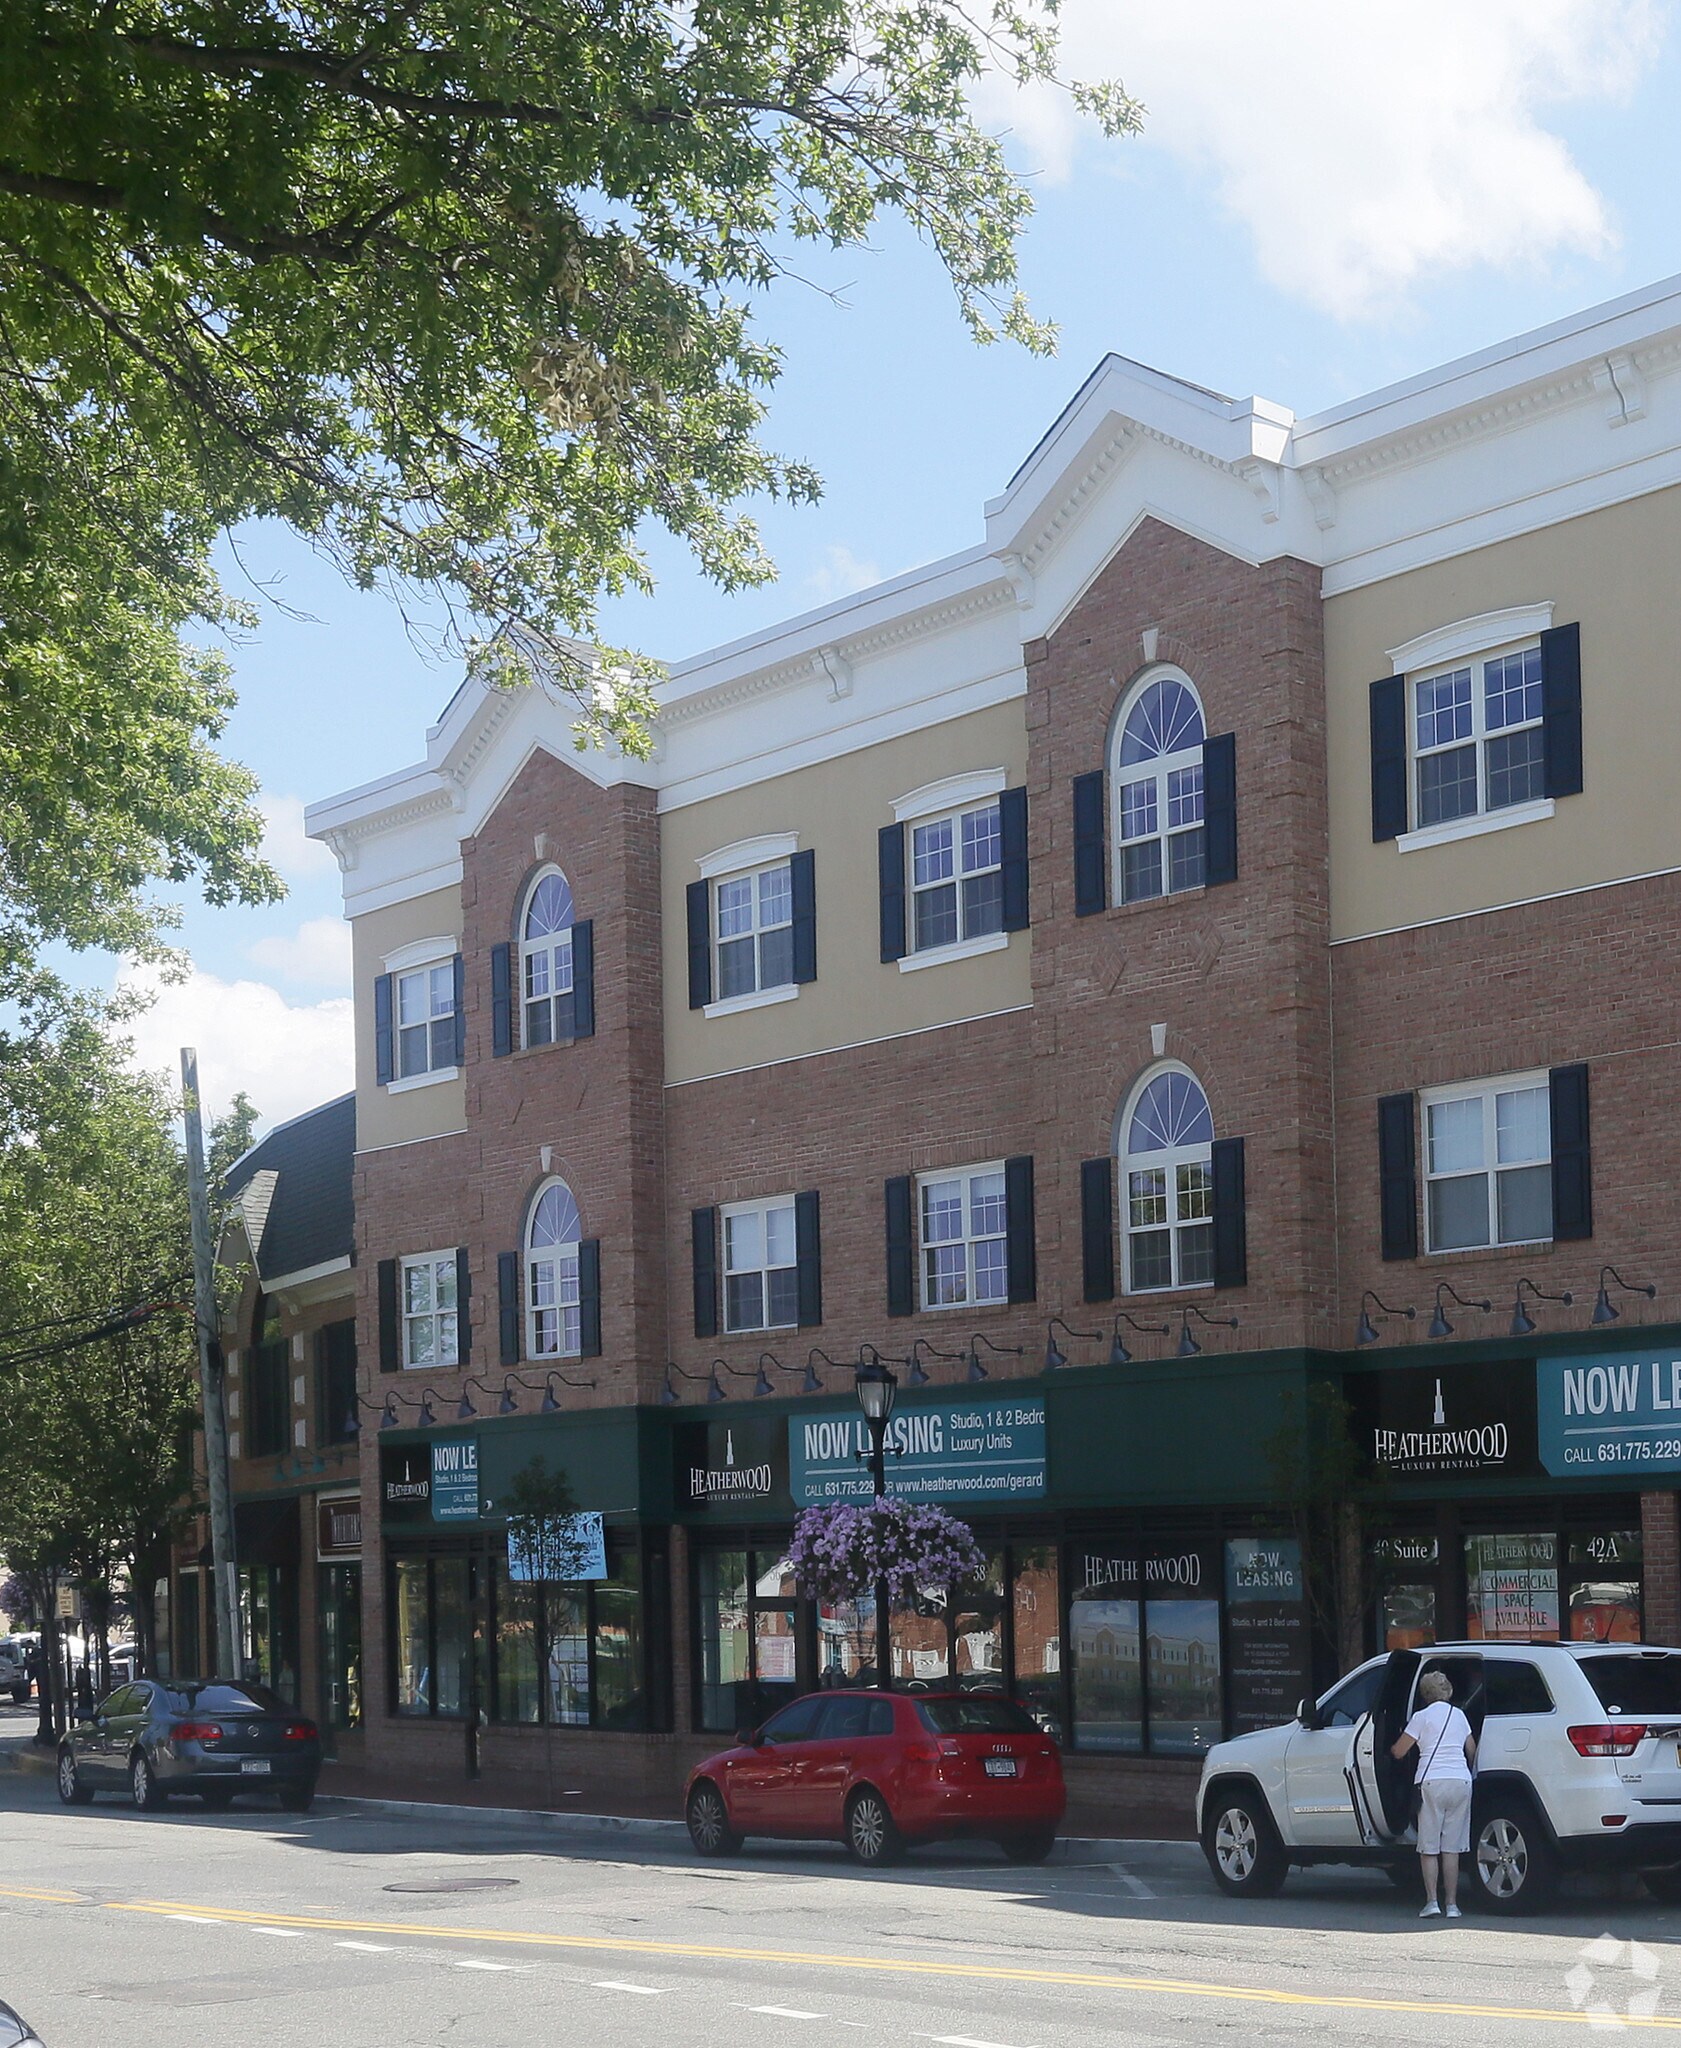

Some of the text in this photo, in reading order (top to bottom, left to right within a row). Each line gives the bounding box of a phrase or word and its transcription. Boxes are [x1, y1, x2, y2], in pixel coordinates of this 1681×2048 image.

[1563, 1364, 1640, 1416] NOW
[950, 1413, 985, 1430] Studio,
[986, 1411, 993, 1428] 1
[995, 1410, 1004, 1427] &
[1006, 1410, 1013, 1426] 2
[804, 1421, 850, 1460] NOW
[951, 1433, 1013, 1454] Luxury Units
[1374, 1422, 1508, 1464] HEATHERWOOD
[434, 1446, 460, 1472] NOW
[1401, 1459, 1480, 1471] LUXURY RENTALS
[1564, 1447, 1595, 1463] CALL
[689, 1463, 772, 1497] HEATHERWOOD
[805, 1484, 824, 1497] CALL
[825, 1480, 876, 1496] 631.775.229
[896, 1471, 1044, 1494] www.heatherwood.com/gerard
[387, 1481, 429, 1500] HEATHERWOOD
[1393, 1539, 1428, 1559] Suite
[1586, 1536, 1619, 1557] 42A
[973, 1564, 986, 1581] 38
[1236, 1570, 1294, 1587] LEASING
[1484, 1574, 1556, 1590] COMMERCIAL
[1503, 1593, 1535, 1608] SPACE
[1495, 1611, 1548, 1626] AVAILABLE
